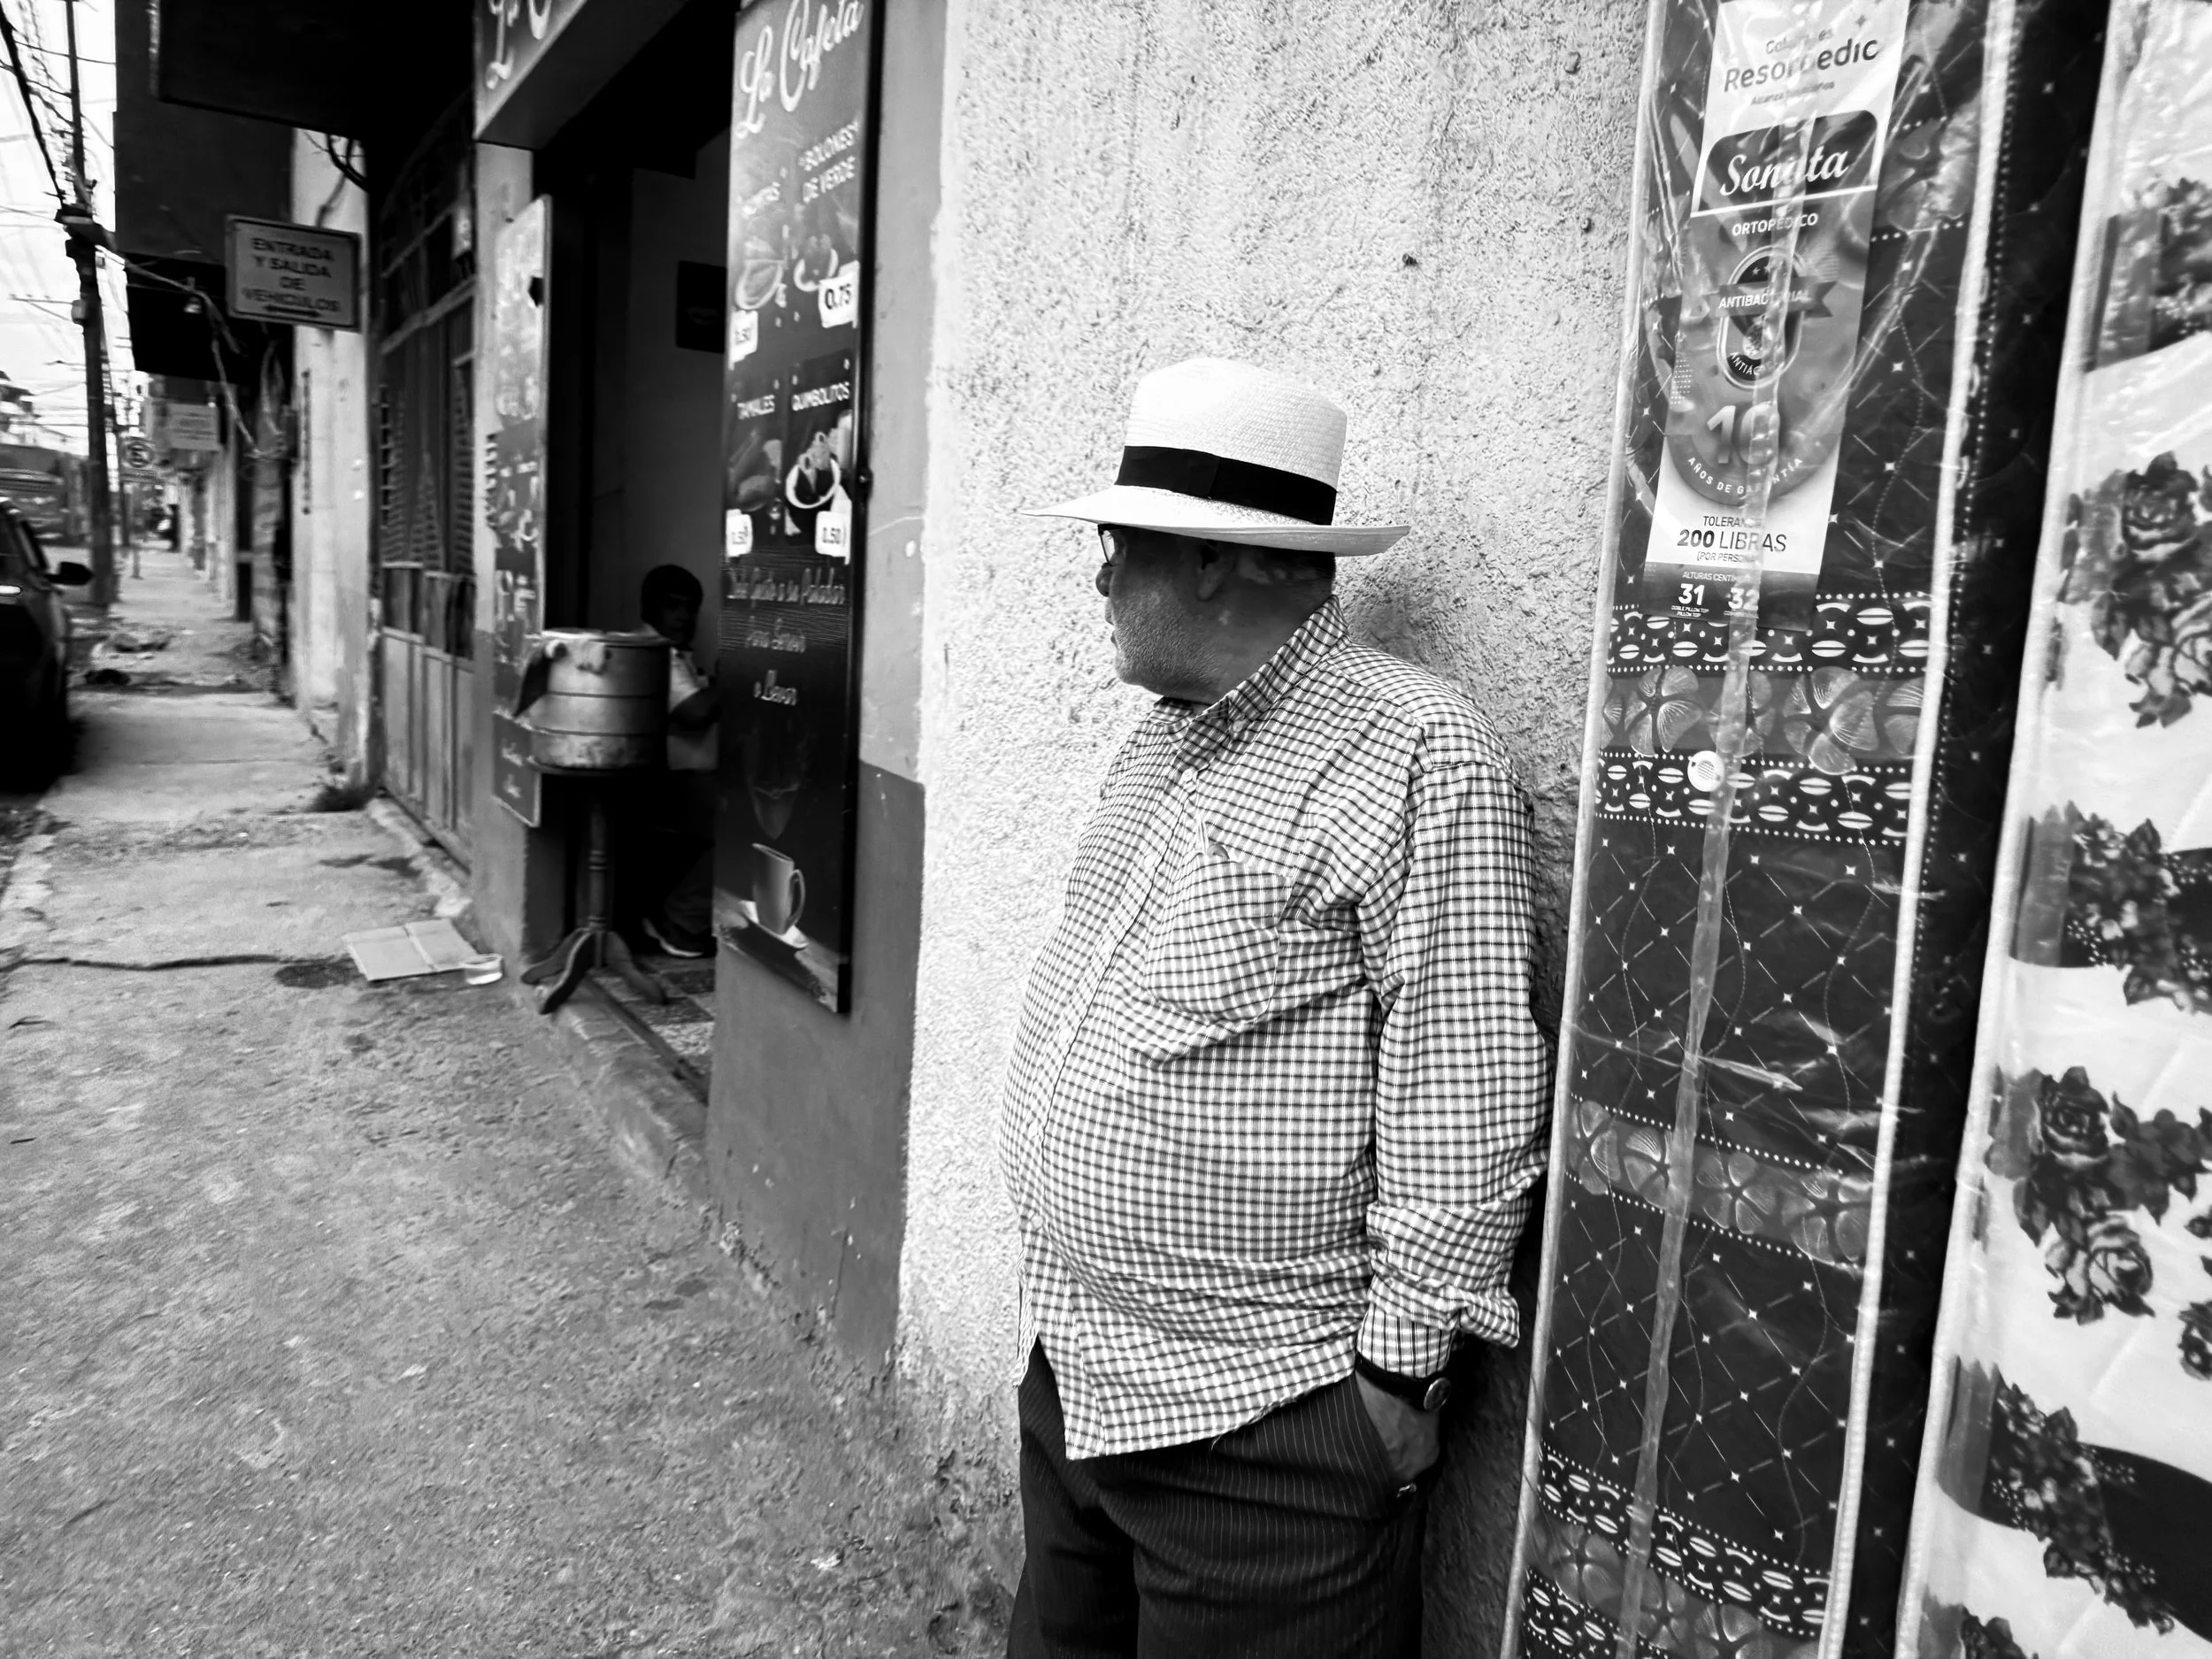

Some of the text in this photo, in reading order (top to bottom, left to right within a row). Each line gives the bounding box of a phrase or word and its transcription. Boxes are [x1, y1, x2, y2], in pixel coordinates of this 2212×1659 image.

[736, 25, 775, 139] La
[1732, 212, 1819, 236] ORTOPEDCO
[251, 237, 334, 262] ENTRADA
[269, 257, 332, 278] SALIDA
[280, 276, 305, 291] DE
[825, 282, 851, 310] 0.75
[1718, 290, 1812, 309] ANTIBACIAL
[1707, 401, 1780, 465] 10
[1687, 457, 1714, 485] AÑOS
[1717, 481, 1732, 494] DE
[1677, 528, 1787, 553] 200 LIBRAS
[1682, 571, 1713, 581] ALTURAS
[1678, 583, 1760, 611] 31 32
